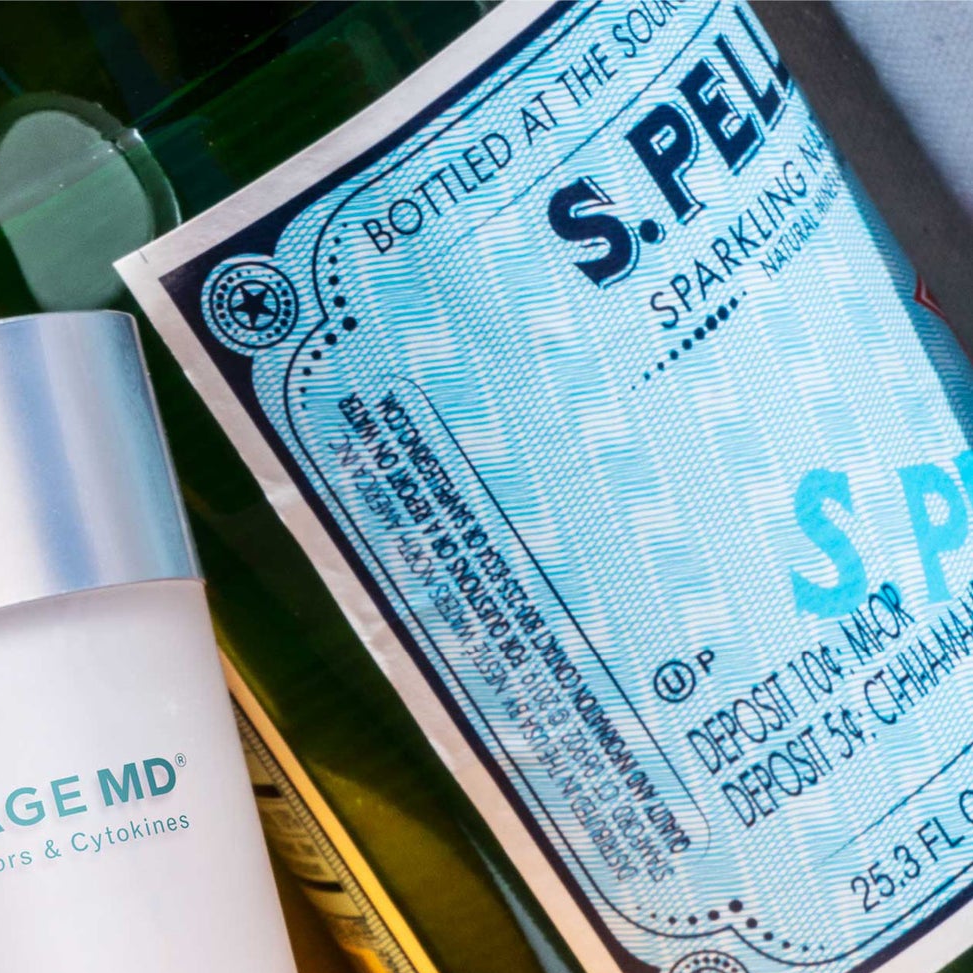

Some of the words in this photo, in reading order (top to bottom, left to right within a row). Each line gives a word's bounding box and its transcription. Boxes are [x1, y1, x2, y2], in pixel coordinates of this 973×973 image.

[362, 132, 512, 254] BOTTLED
[520, 90, 558, 146] AT
[555, 43, 618, 107] THE
[649, 160, 807, 329] SPARKLING
[759, 207, 820, 281] NATURAL
[337, 392, 381, 444] WATER
[368, 439, 399, 471] ON
[348, 463, 405, 535] AMERICA
[385, 465, 434, 523] REPORT
[421, 519, 444, 538] A
[430, 532, 459, 561] OR
[461, 524, 488, 550] OR
[392, 529, 440, 587] NORTH
[427, 582, 478, 645] WATERS
[446, 555, 511, 639] QUESTIONS
[474, 544, 544, 635] 800-255-8334
[462, 640, 513, 698] NESTLÉ
[498, 634, 530, 668] FOR
[530, 628, 582, 691] CONTACT
[516, 714, 550, 751] USA
[567, 684, 638, 775] INFORMATION
[686, 672, 798, 775] DEPOSIT
[537, 745, 568, 778] THE
[561, 728, 604, 779] 06902
[721, 725, 833, 828] DEPOSIT
[556, 774, 582, 799] IN
[624, 769, 657, 804] AND
[43, 838, 62, 860] &
[70, 811, 191, 853] Cytokines
[569, 793, 637, 883] DISTRIBUTED
[643, 798, 691, 856] QUALITY
[850, 844, 921, 913] 25.3
[916, 816, 966, 862] FL
